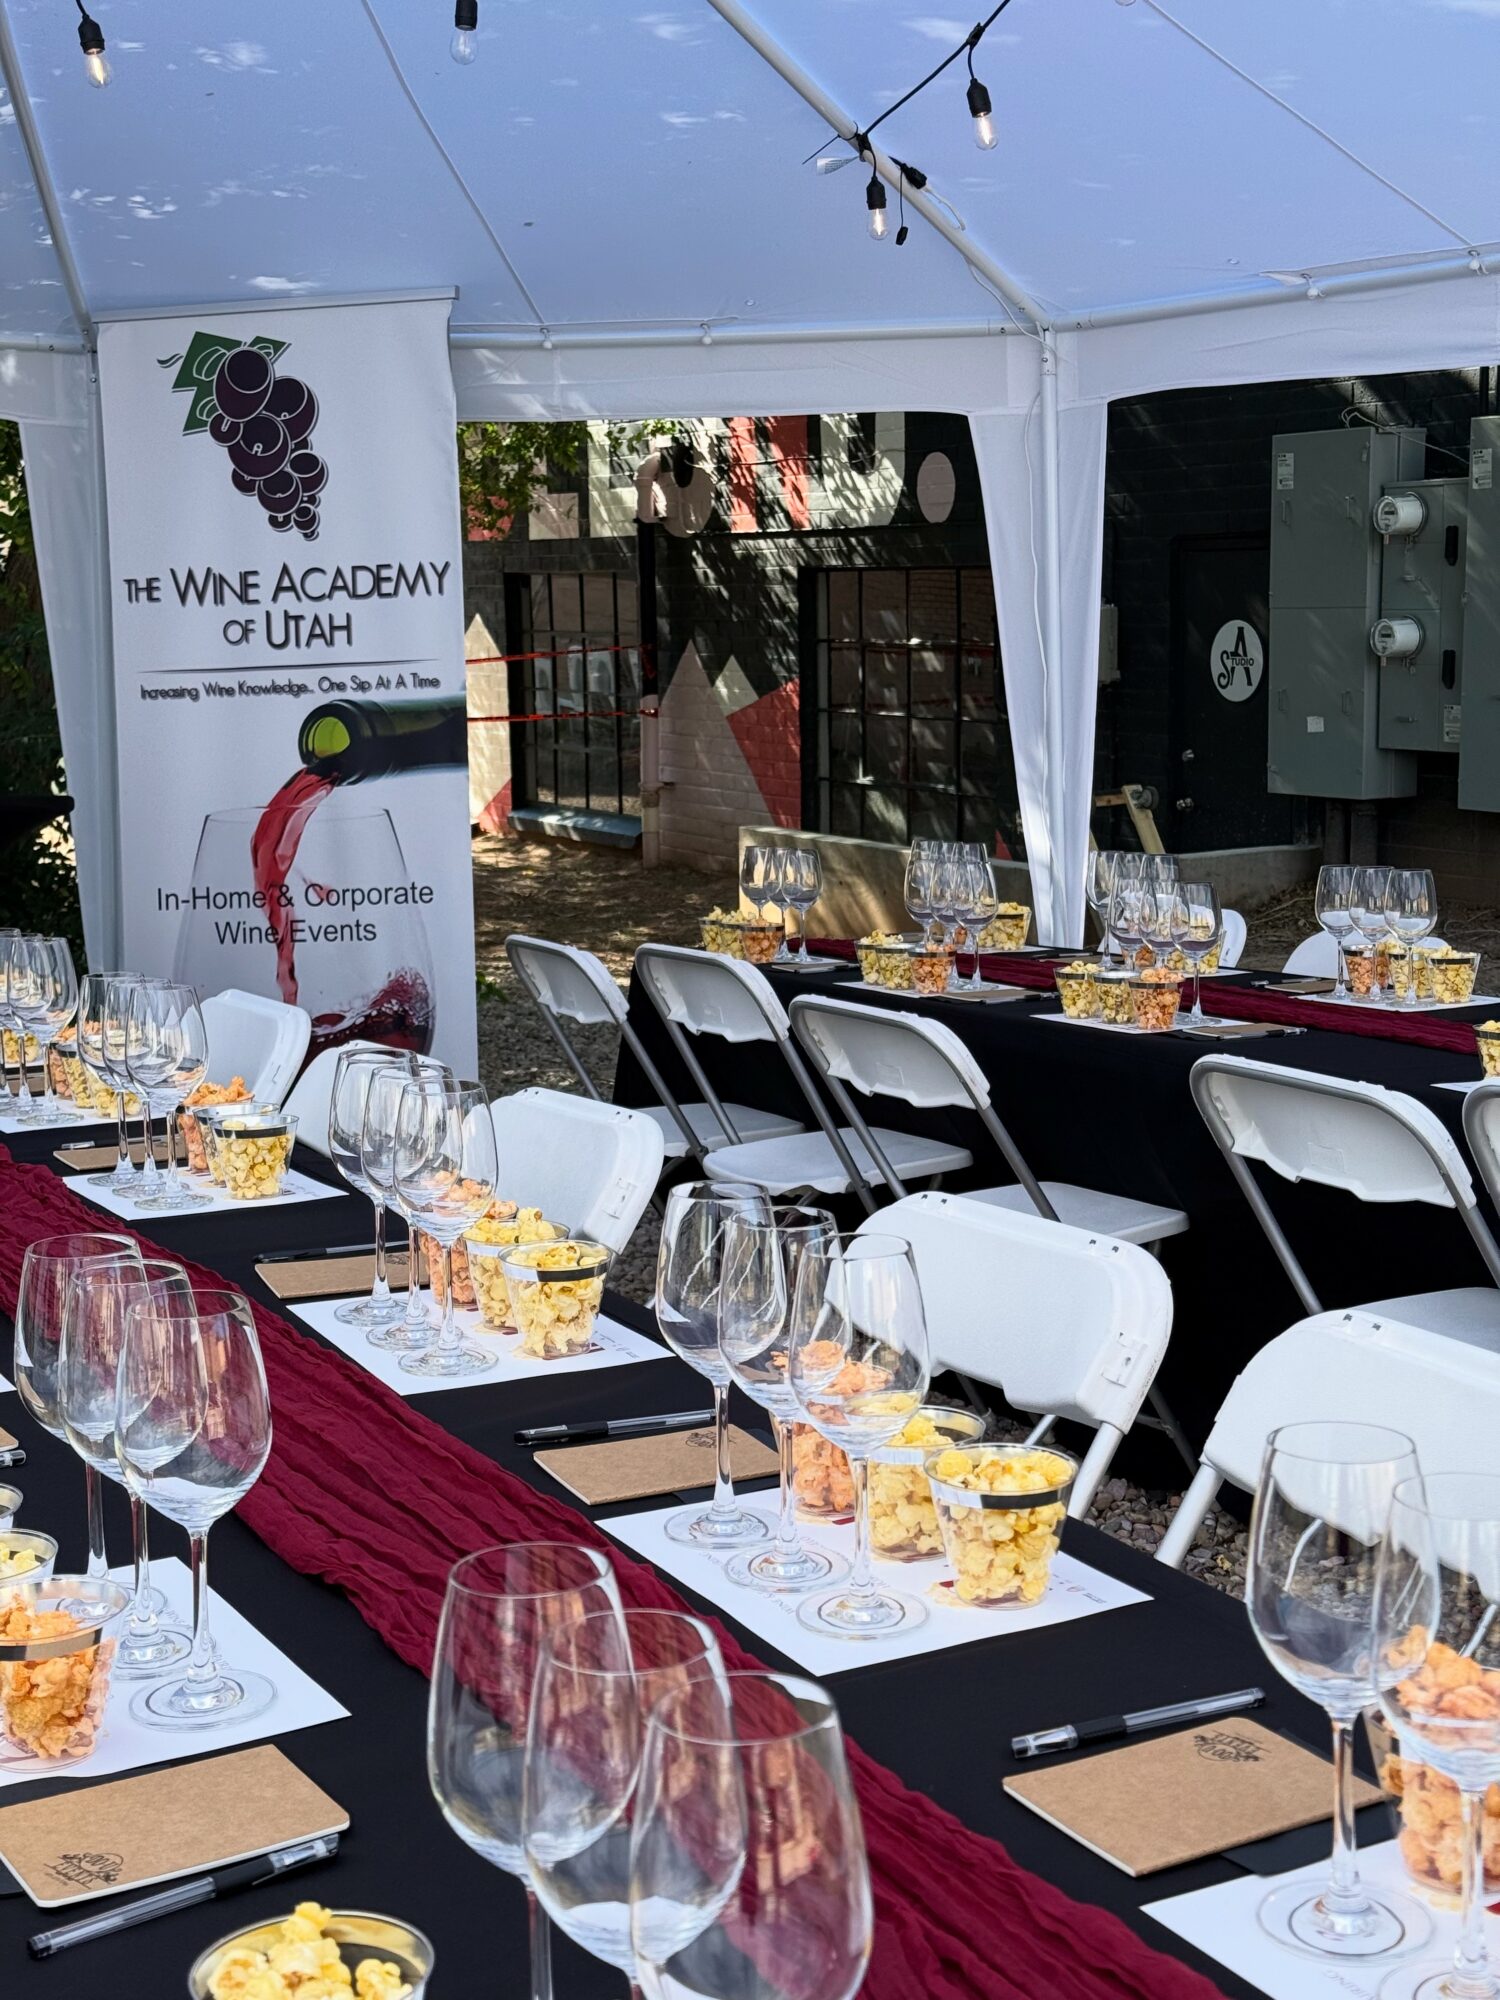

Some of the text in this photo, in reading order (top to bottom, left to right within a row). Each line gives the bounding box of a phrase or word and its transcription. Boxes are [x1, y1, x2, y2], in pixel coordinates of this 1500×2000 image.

[123, 561, 451, 608] THE WINE ACADEMY
[222, 609, 353, 650] OF UTAH
[140, 684, 200, 702] Increasing
[202, 681, 236, 698] Wine
[317, 676, 348, 693] One
[350, 674, 372, 693] Sip
[375, 674, 391, 690] At
[395, 673, 407, 689] A
[409, 672, 441, 689] Time
[157, 882, 434, 912] In-Home & Corporate
[215, 919, 377, 945] Wine Events
